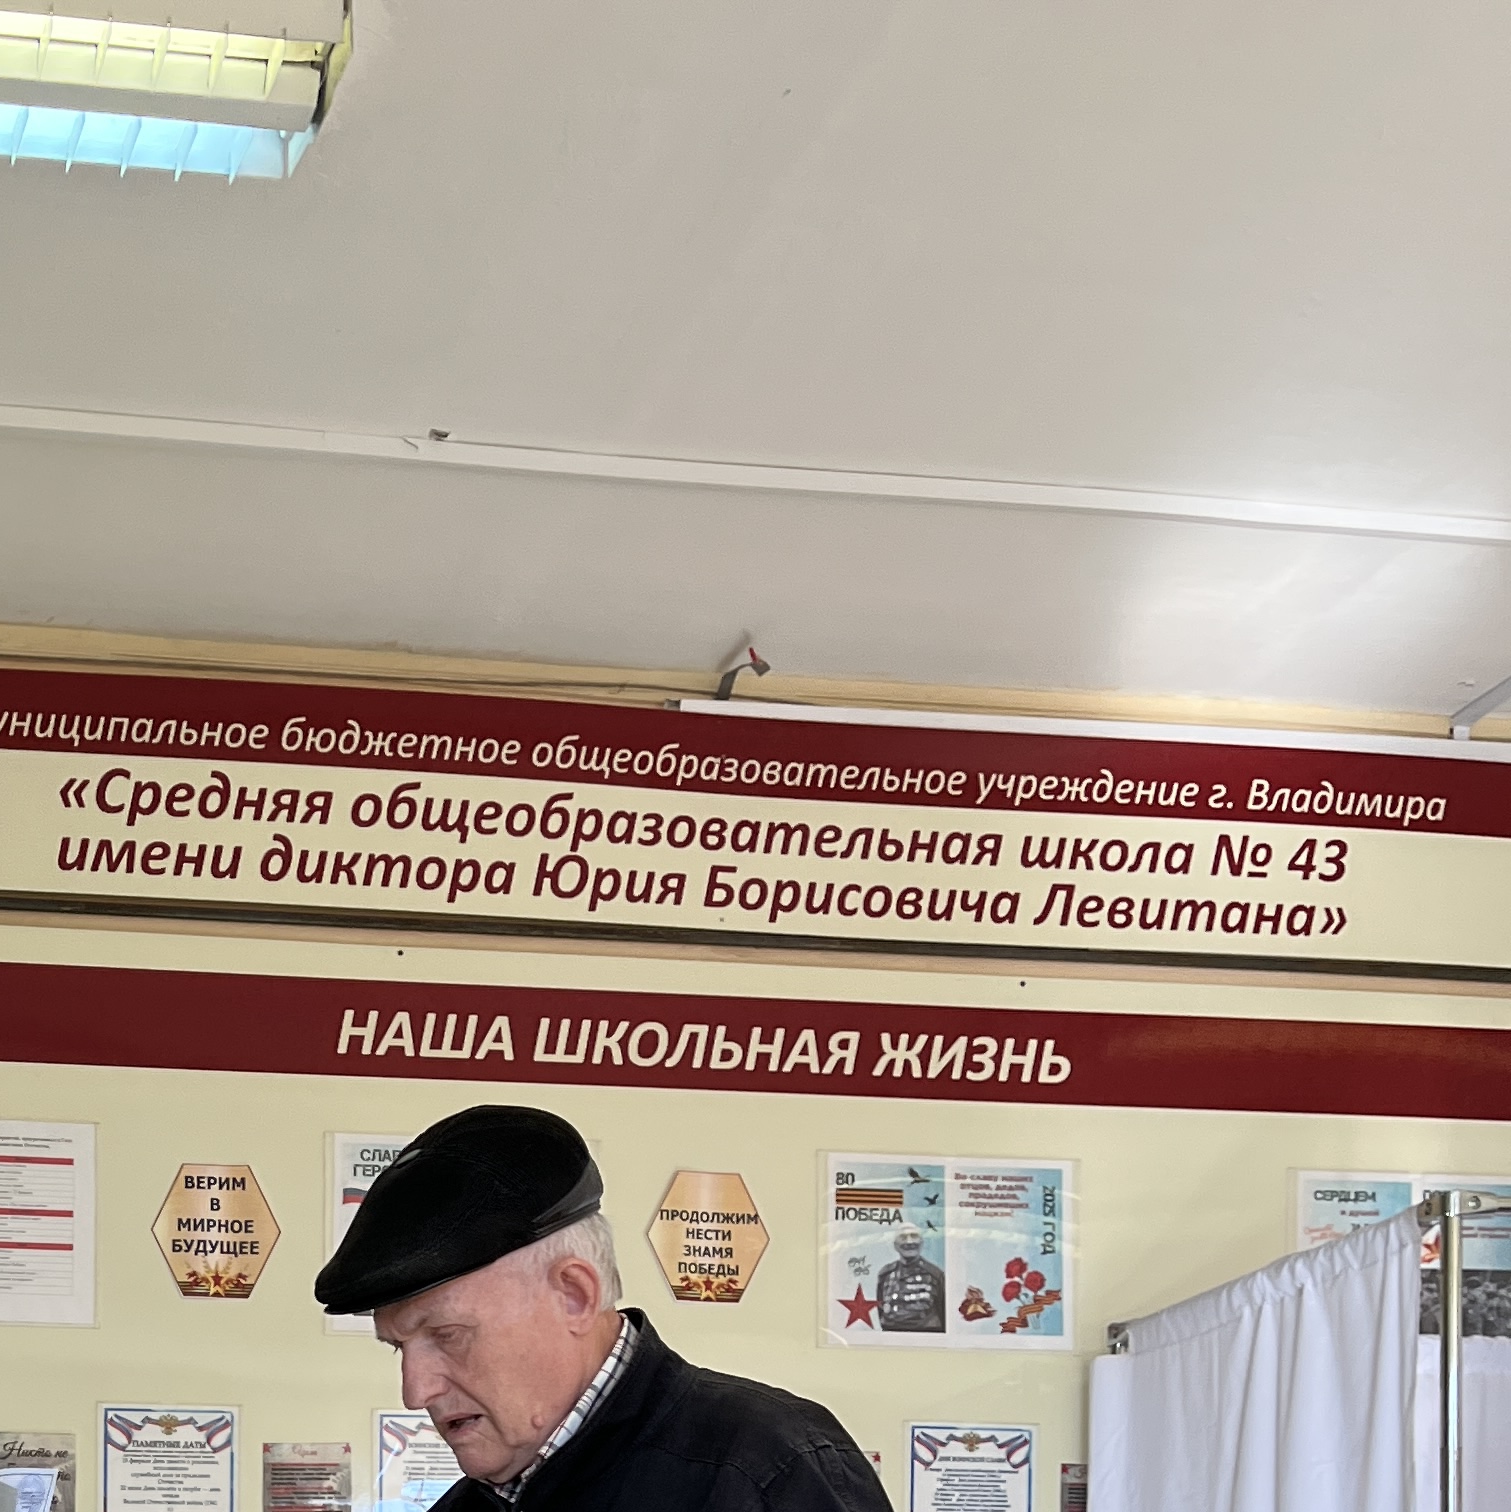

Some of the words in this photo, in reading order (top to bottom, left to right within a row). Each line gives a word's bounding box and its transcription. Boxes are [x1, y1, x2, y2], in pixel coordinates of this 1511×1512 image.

[281, 715, 521, 766] бюджетное
[531, 737, 966, 796] общеобразовательное
[977, 768, 1199, 809] учреждение
[1208, 786, 1235, 811] г.
[1247, 777, 1447, 824] Владимира
[58, 767, 334, 827] «Средняя
[352, 782, 1002, 868] общеобразовательная
[1020, 833, 1191, 876] школа
[1210, 834, 1273, 881] №
[1288, 838, 1349, 884] 43
[58, 836, 242, 880] имени
[260, 833, 516, 904] диктора
[532, 853, 686, 912] Юрия
[703, 864, 1020, 926] Борисовича
[1035, 883, 1349, 939] Левитана»
[337, 1008, 515, 1062] НАША
[533, 1016, 860, 1077] ШКОЛЬНАЯ
[873, 1030, 1073, 1085] ЖИЗНЬ
[360, 1148, 401, 1163] СЛАВ
[183, 1174, 247, 1191] ВЕРИМ
[835, 1171, 856, 1186] 80
[210, 1197, 221, 1212] В
[1042, 1185, 1056, 1217] 2025
[659, 1208, 759, 1227] ПРОДОЛЖИМ
[834, 1206, 904, 1226] ПОБЕДА
[176, 1217, 255, 1235] МИРНОЕ
[685, 1227, 732, 1242] НЕСТИ
[171, 1238, 260, 1257] БУДУЩЕЕ
[1040, 1221, 1056, 1256] ГОД
[682, 1244, 734, 1259] ЗНАМЯ
[677, 1260, 740, 1278] ПОБЕДЫ
